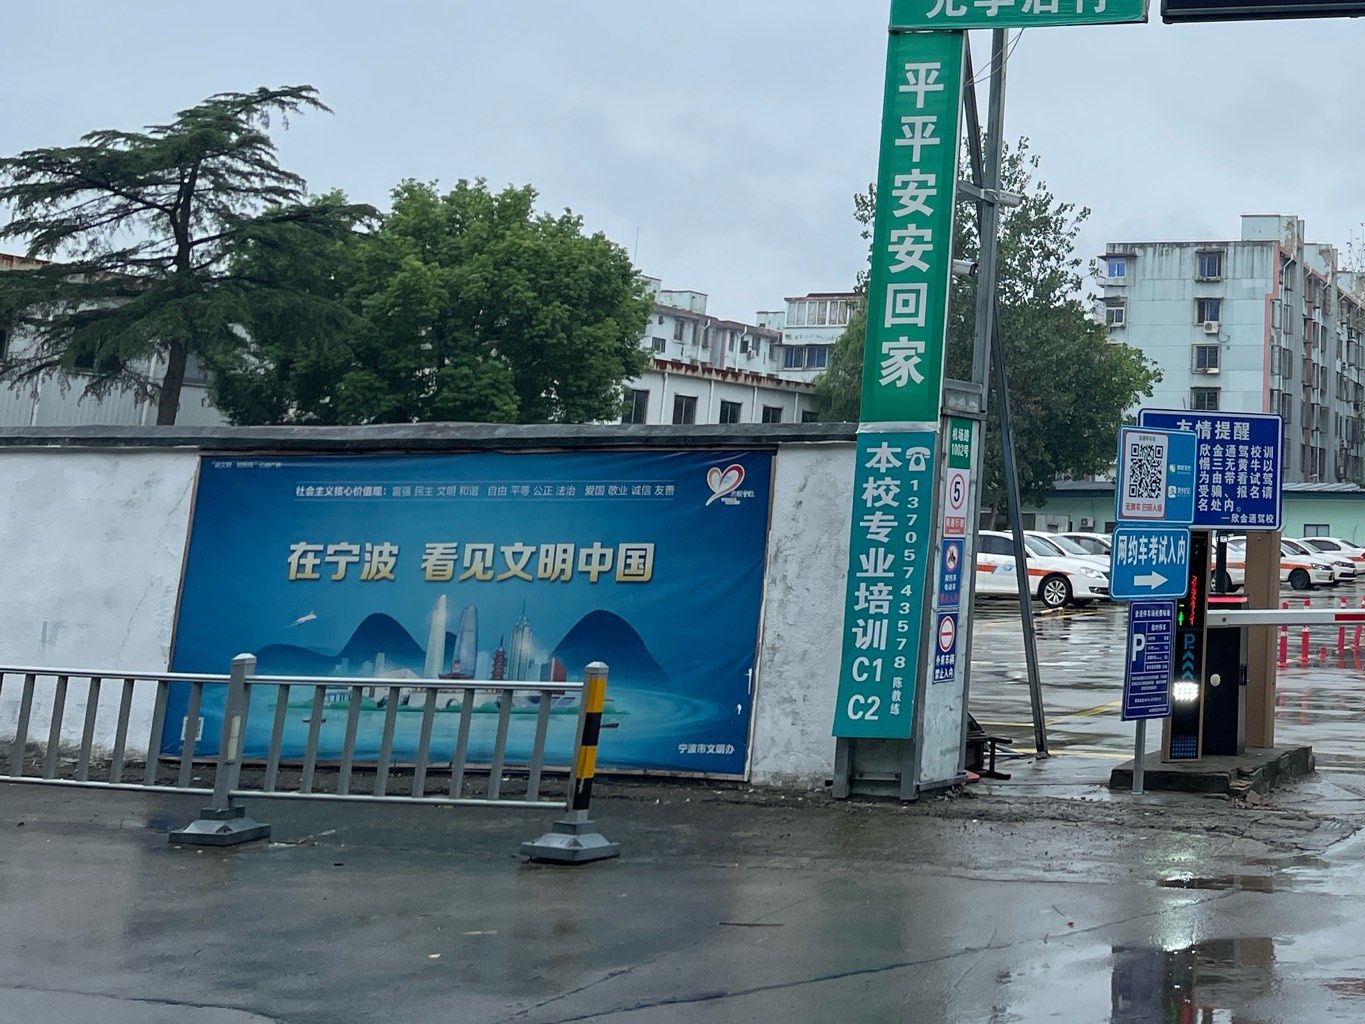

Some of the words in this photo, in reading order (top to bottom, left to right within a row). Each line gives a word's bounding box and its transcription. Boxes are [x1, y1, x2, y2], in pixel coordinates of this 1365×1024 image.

[879, 61, 945, 388] 平平安安回家
[1199, 443, 1274, 459] 欣金通驾校训
[953, 481, 961, 502] 5
[852, 441, 902, 651] 本校专业培训
[1116, 535, 1186, 566] 网约车考试入内
[287, 542, 399, 582] 在宁波
[421, 542, 655, 583] 看见文明中国
[852, 657, 882, 683] C1
[846, 694, 881, 722] C2
